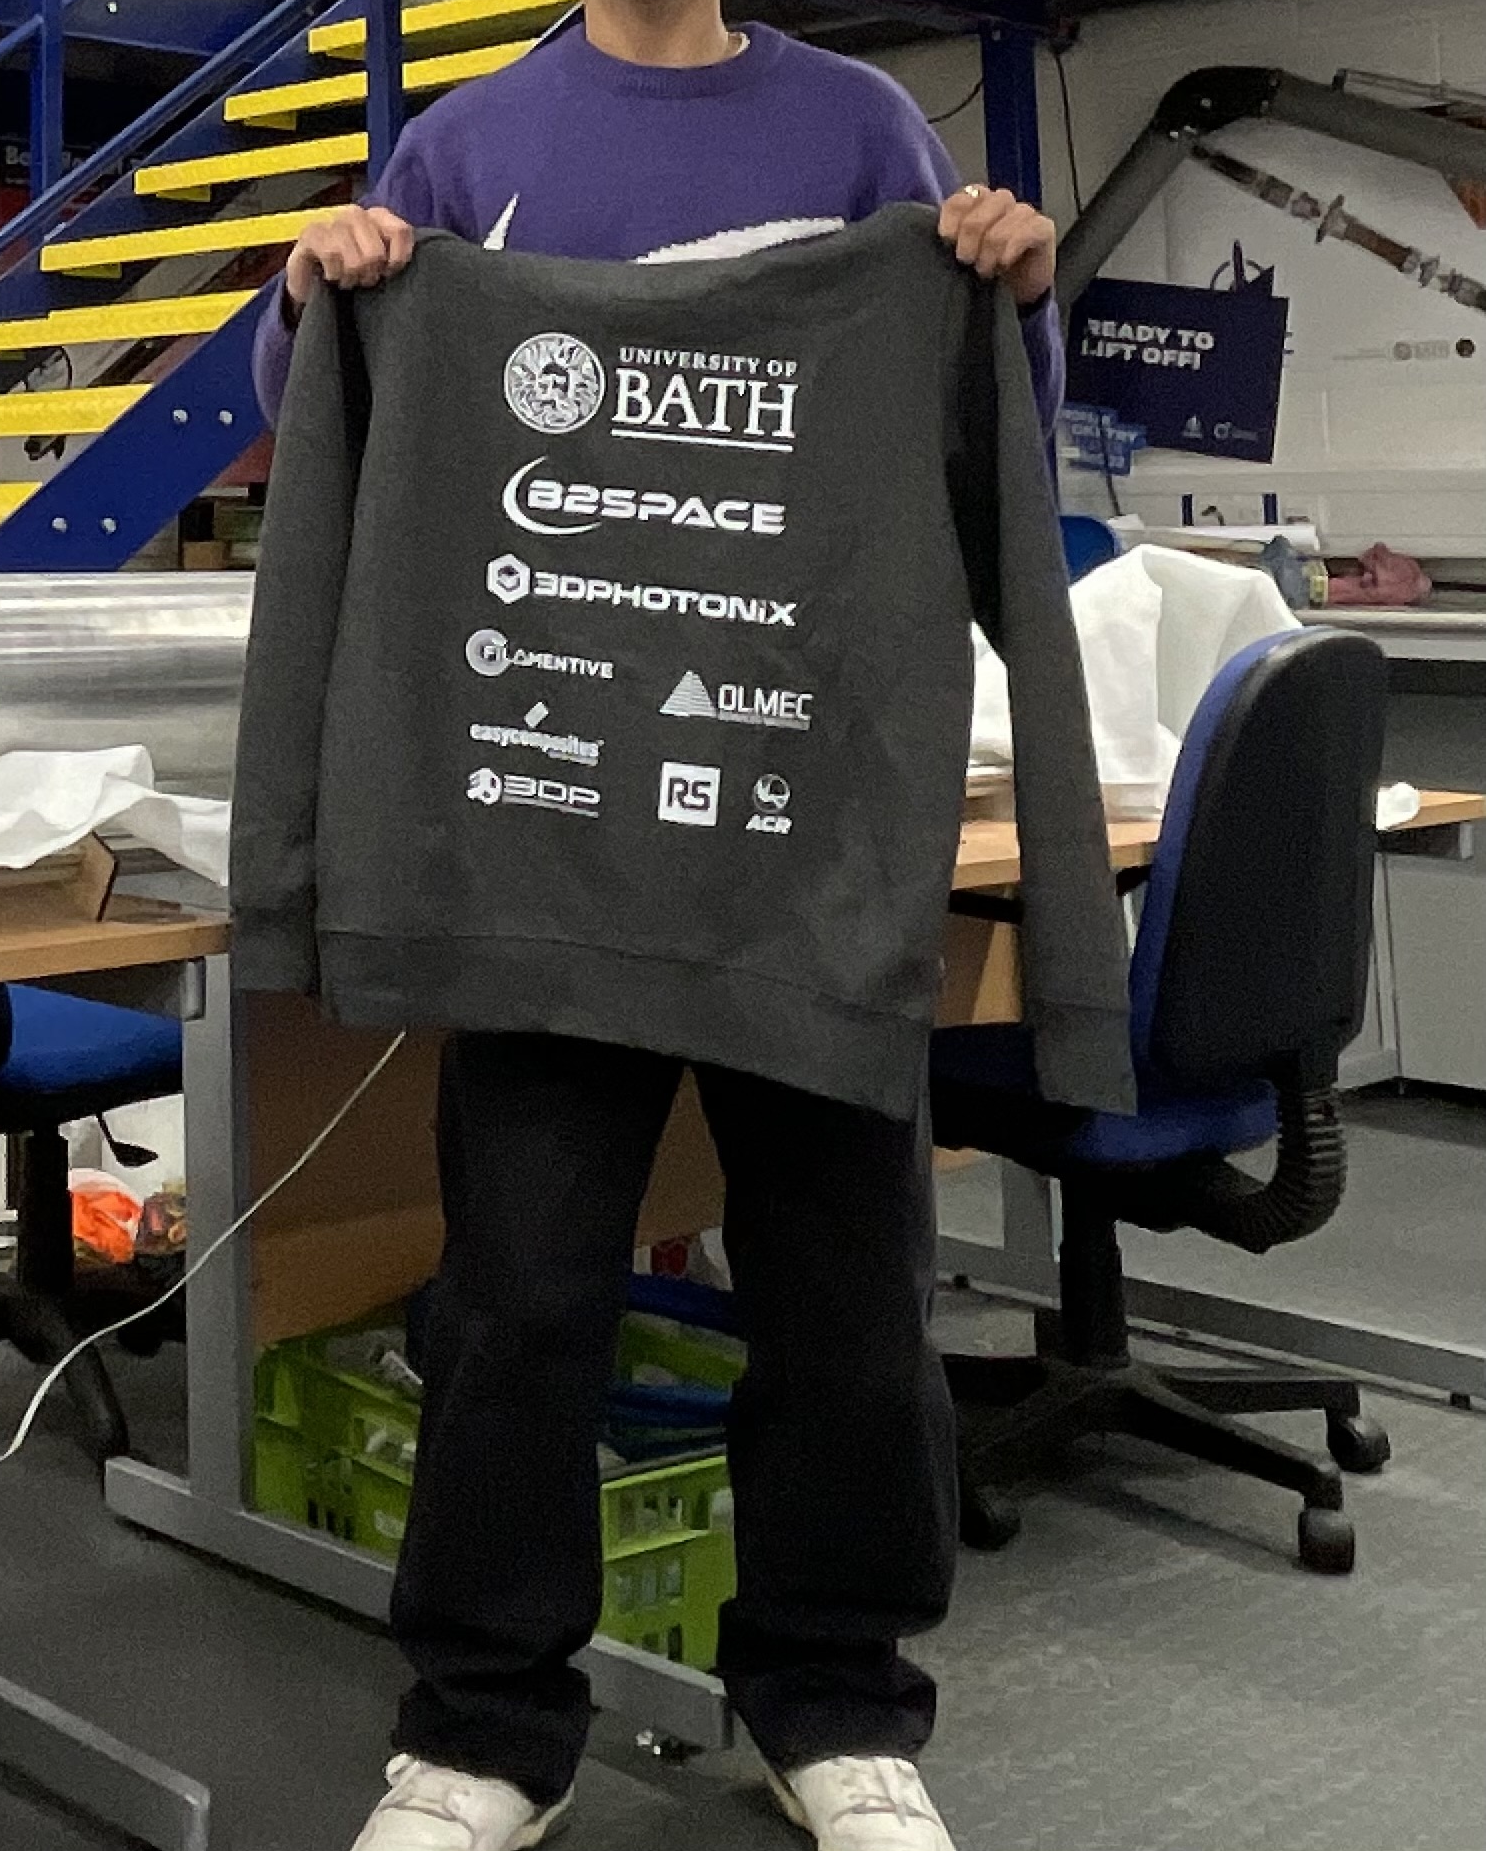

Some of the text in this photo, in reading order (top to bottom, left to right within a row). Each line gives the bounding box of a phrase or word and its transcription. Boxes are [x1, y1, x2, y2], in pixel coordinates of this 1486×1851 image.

[1081, 338, 1137, 362] LIFT
[1085, 317, 1215, 351] READY TO
[619, 347, 798, 379] UNIVERSITY OF
[610, 367, 800, 439] BATH
[526, 478, 787, 535] B2SPACE
[717, 683, 814, 721] OLMEC
[503, 773, 601, 805] 3DP
[667, 777, 712, 811] RS
